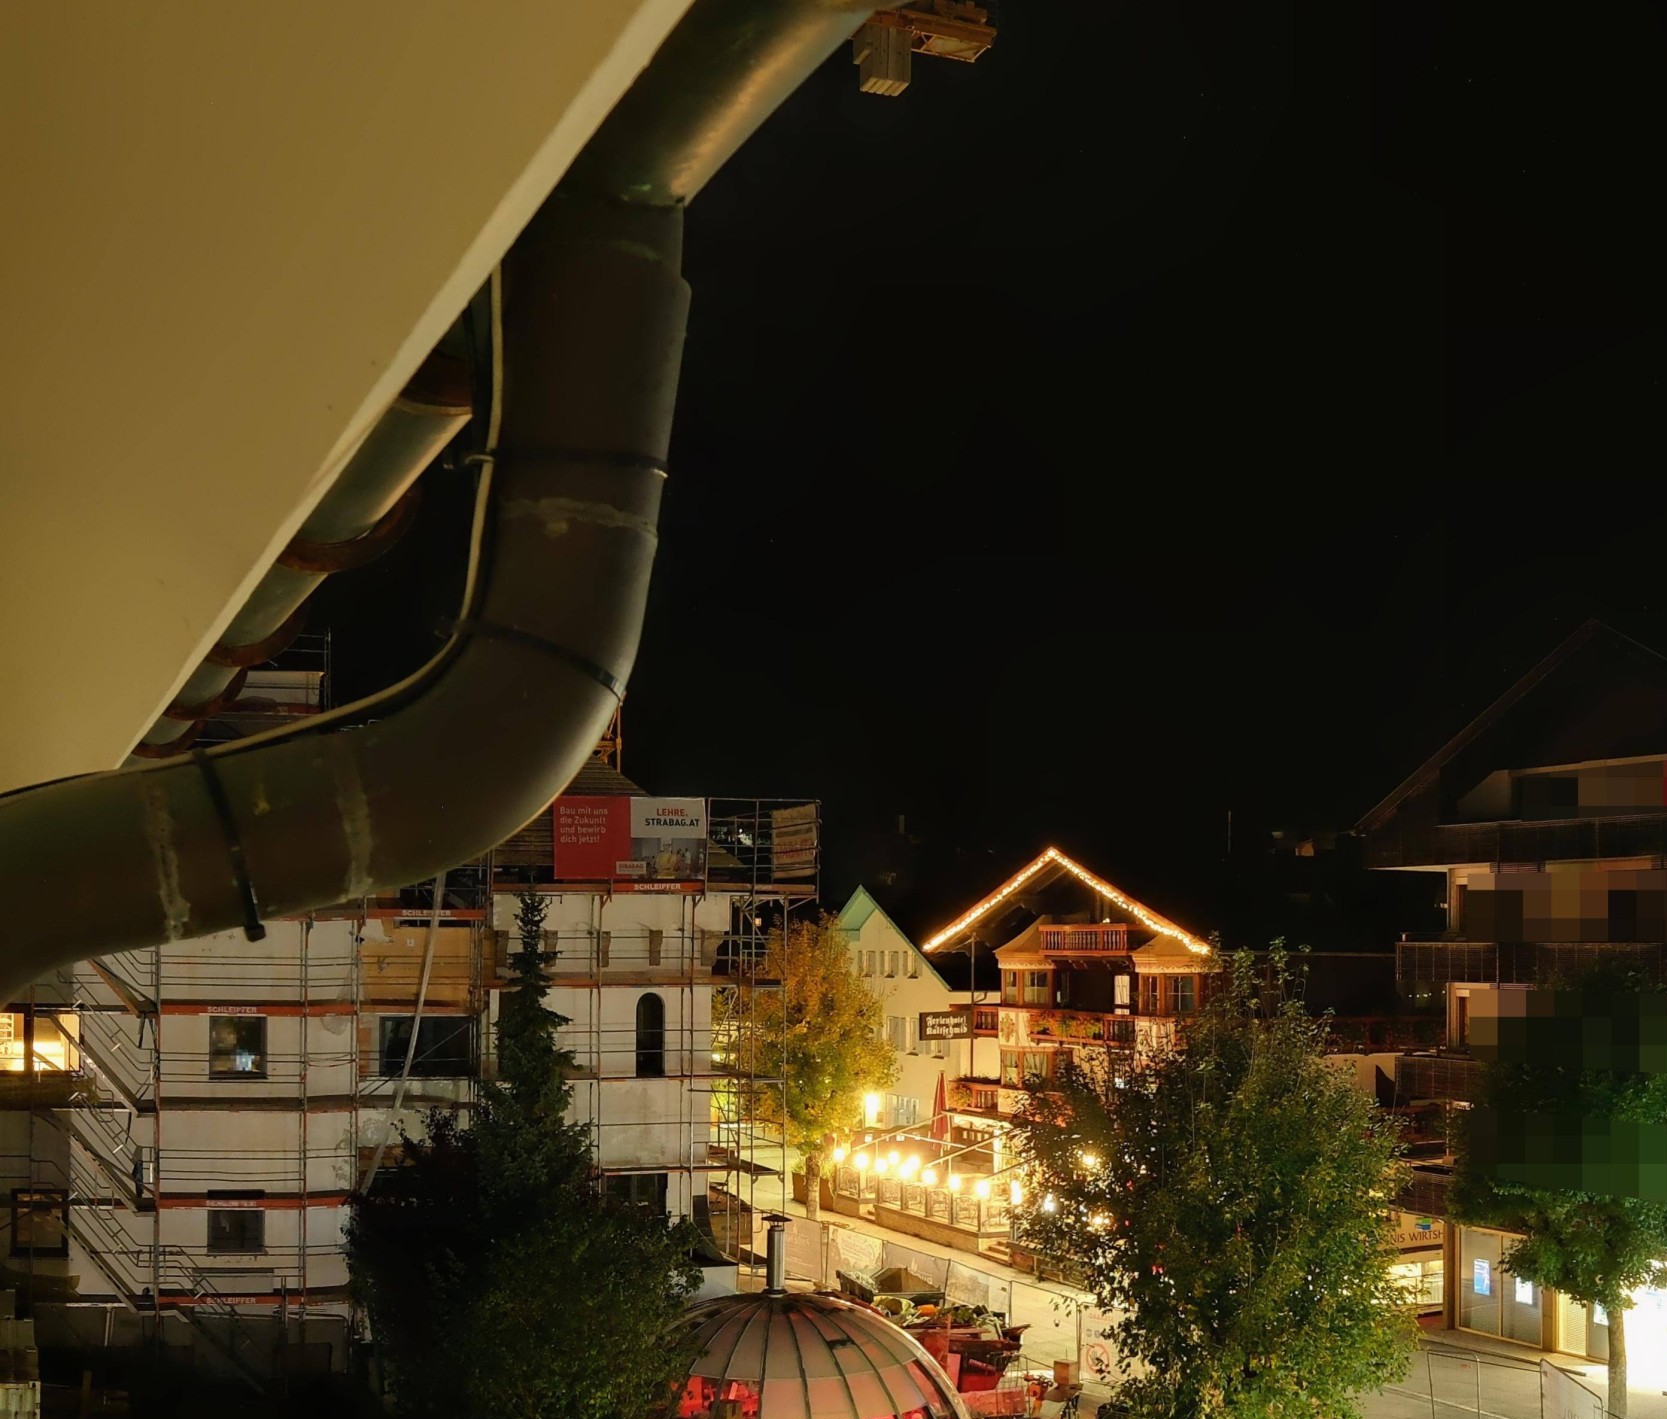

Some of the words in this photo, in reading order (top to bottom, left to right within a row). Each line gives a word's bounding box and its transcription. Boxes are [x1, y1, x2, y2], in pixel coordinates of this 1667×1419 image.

[560, 807, 575, 815] Bau
[577, 807, 591, 815] mit
[656, 808, 688, 817] LEHRE.
[560, 816, 573, 824] die
[574, 816, 606, 825] Zukunft
[645, 818, 700, 827] STRABAG.AT
[560, 826, 576, 834] und
[577, 826, 606, 834] bewirb
[560, 835, 576, 843] dich
[578, 835, 600, 845] jetzt!
[402, 909, 451, 917] SCHLEFER
